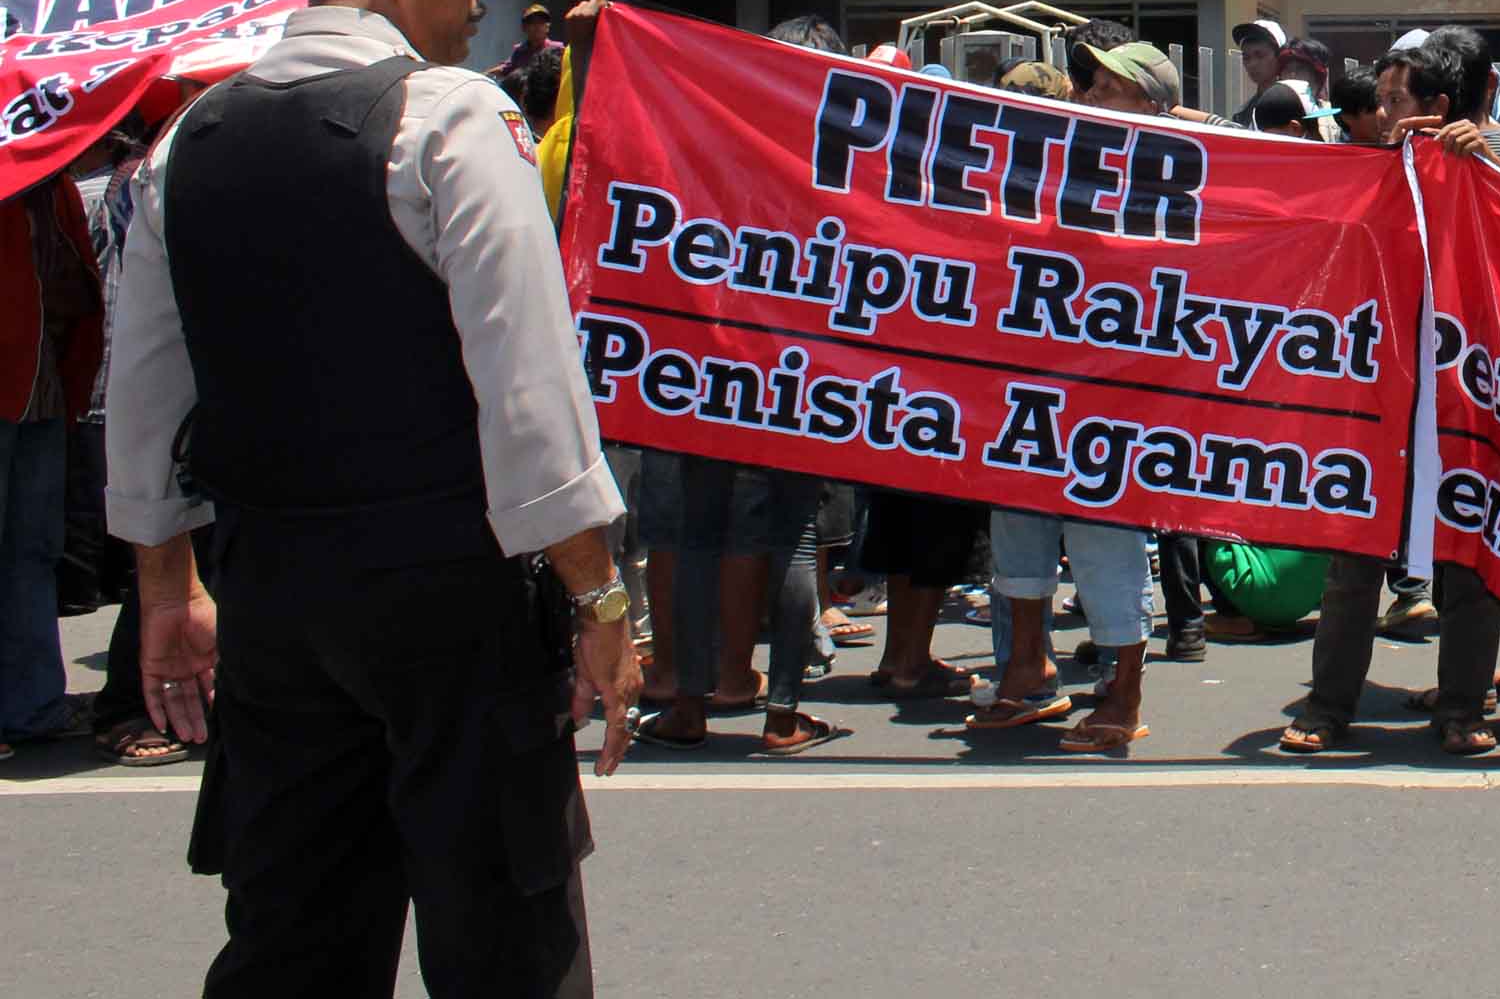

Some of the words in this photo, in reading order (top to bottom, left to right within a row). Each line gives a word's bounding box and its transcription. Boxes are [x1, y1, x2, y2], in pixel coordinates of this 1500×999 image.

[812, 68, 1207, 245] PIETER
[598, 181, 976, 335] Penipu
[997, 247, 1383, 390] Rakyat
[575, 312, 965, 460] Penista
[983, 382, 1375, 517] Agama
